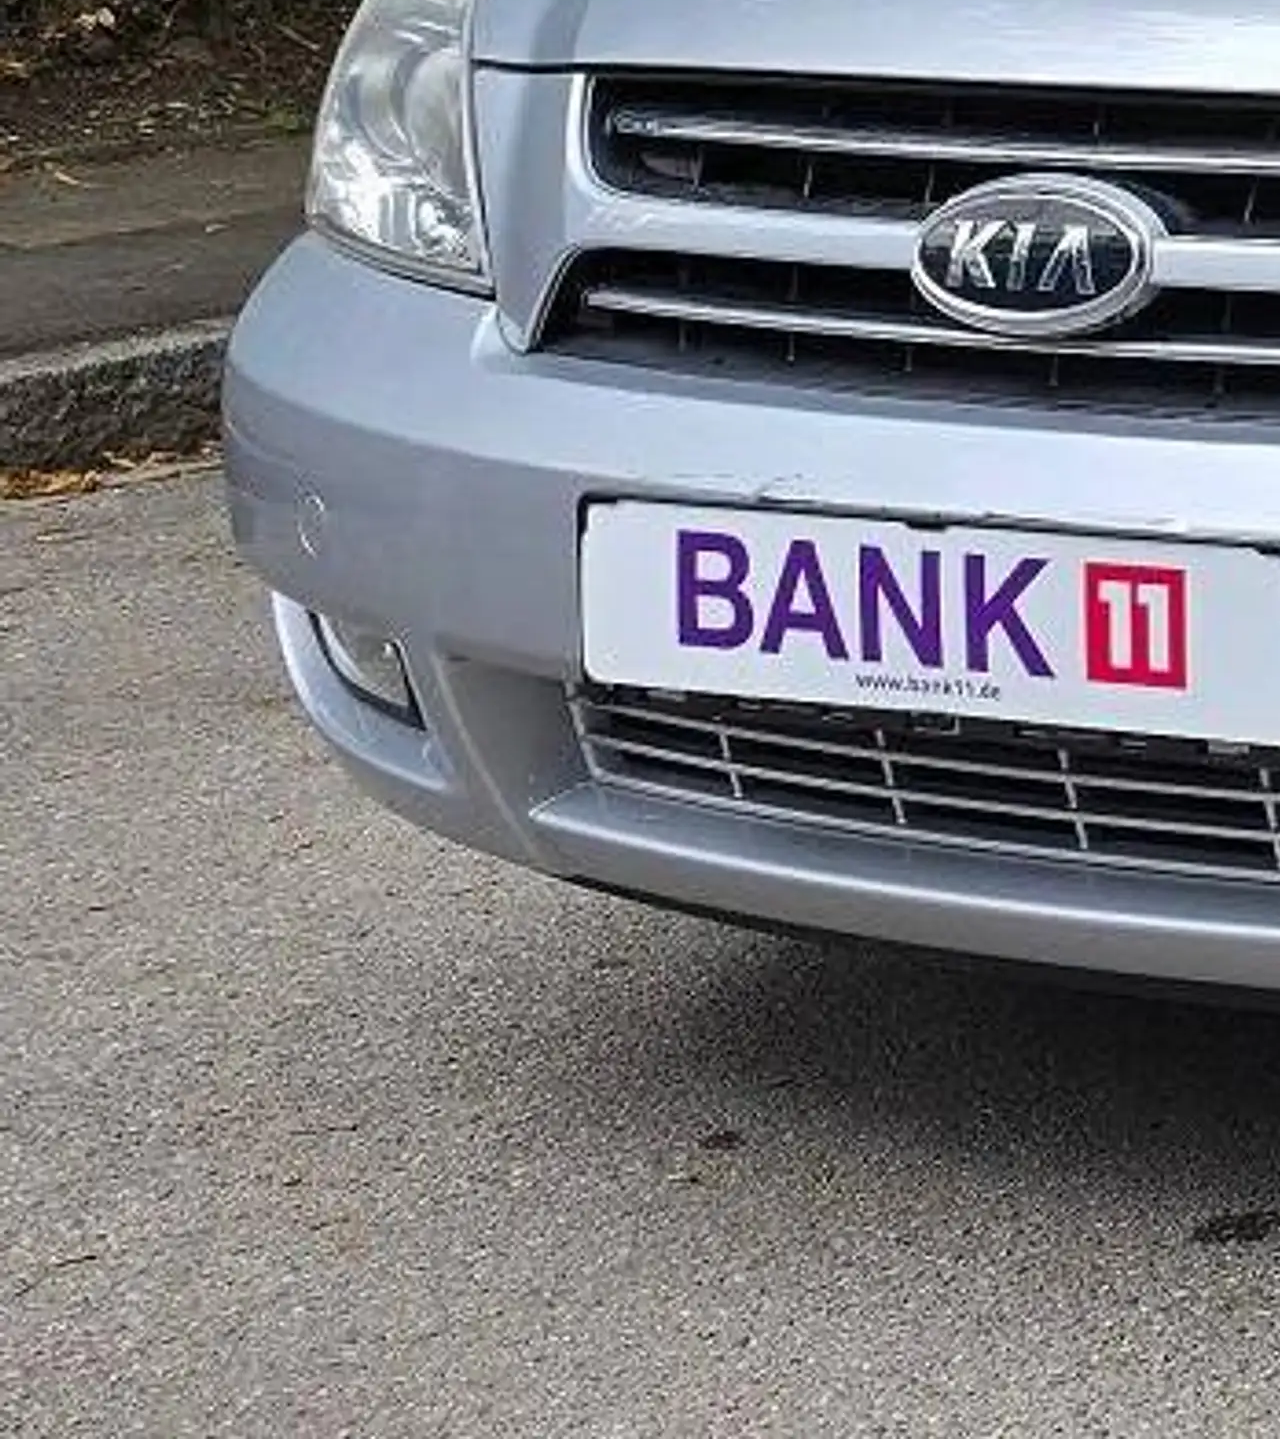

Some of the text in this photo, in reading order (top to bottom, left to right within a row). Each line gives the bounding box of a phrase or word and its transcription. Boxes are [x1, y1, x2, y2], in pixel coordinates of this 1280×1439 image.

[944, 219, 1097, 296] KIA
[676, 528, 1173, 679] BANK 11
[854, 673, 1001, 702] www.bank11.de
